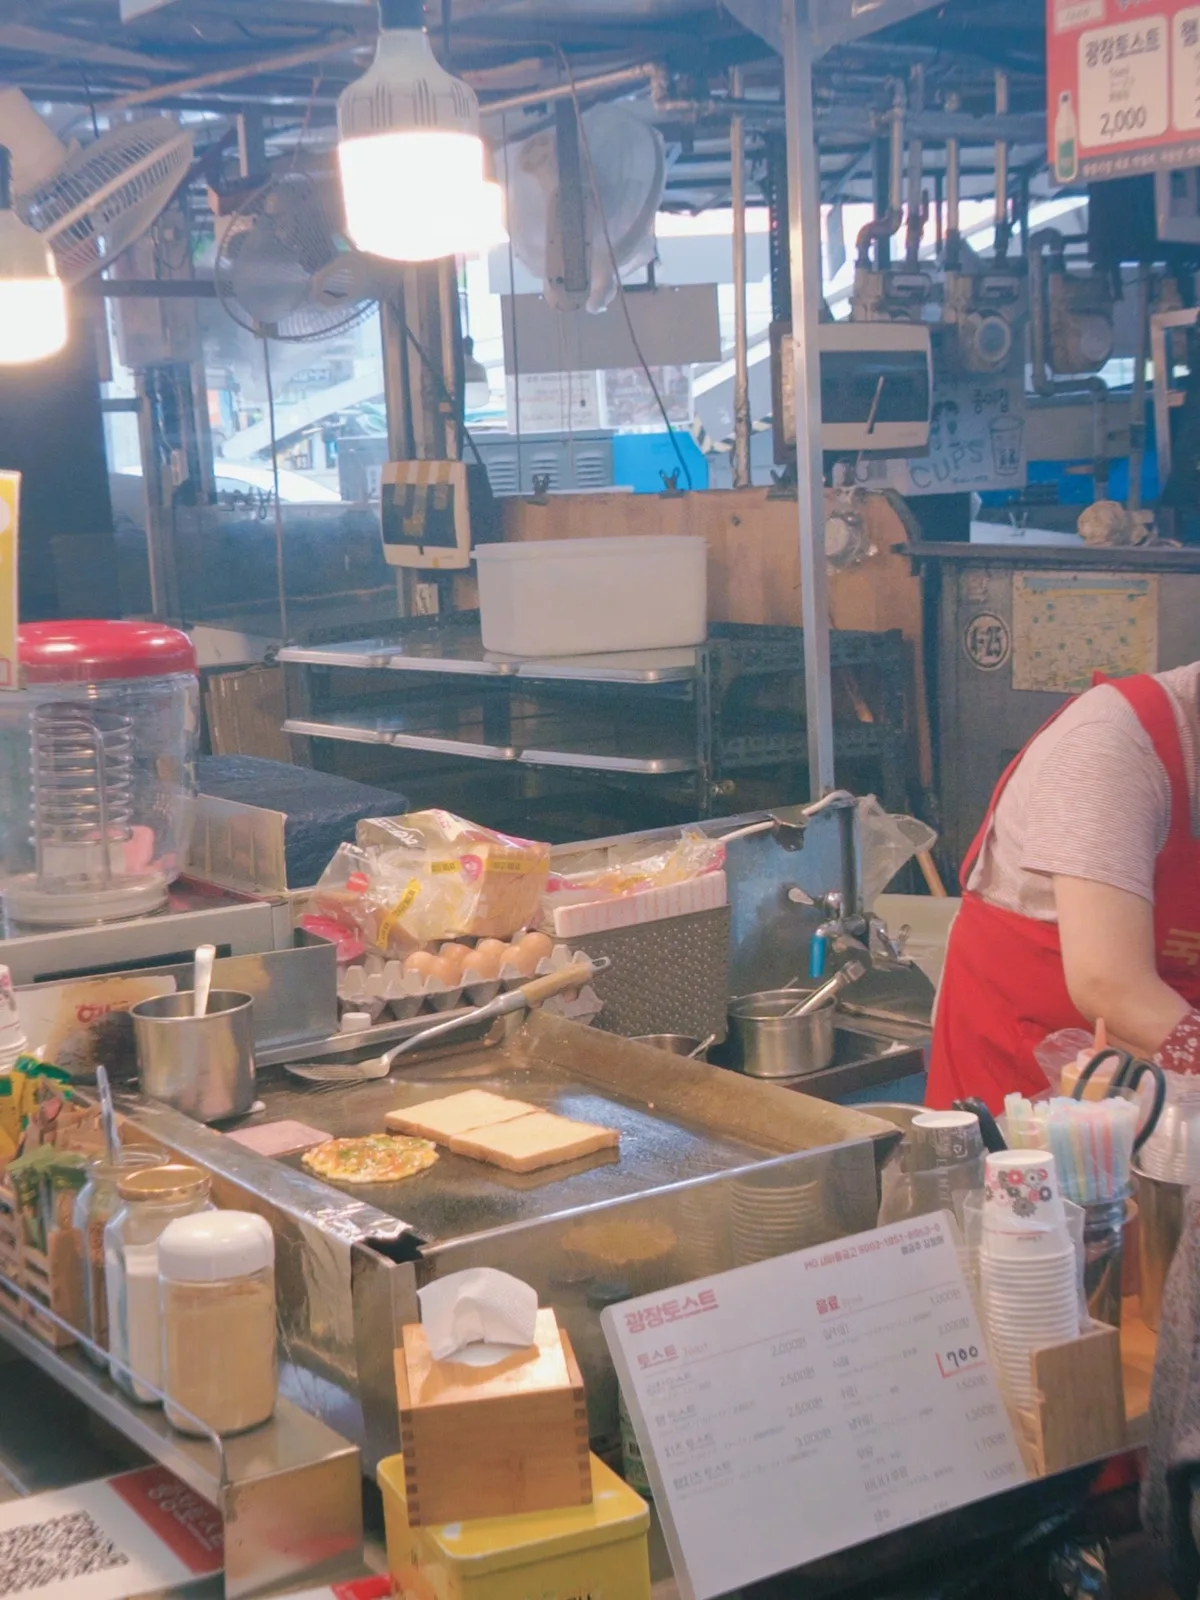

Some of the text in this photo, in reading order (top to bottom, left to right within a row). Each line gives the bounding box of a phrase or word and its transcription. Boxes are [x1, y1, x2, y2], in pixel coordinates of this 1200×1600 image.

[1085, 27, 1160, 67] 광장토스트
[1100, 106, 1147, 138] 2,000
[624, 1289, 719, 1334] 광장토스트
[637, 1344, 679, 1369] 토스트
[946, 1345, 978, 1368] 700
